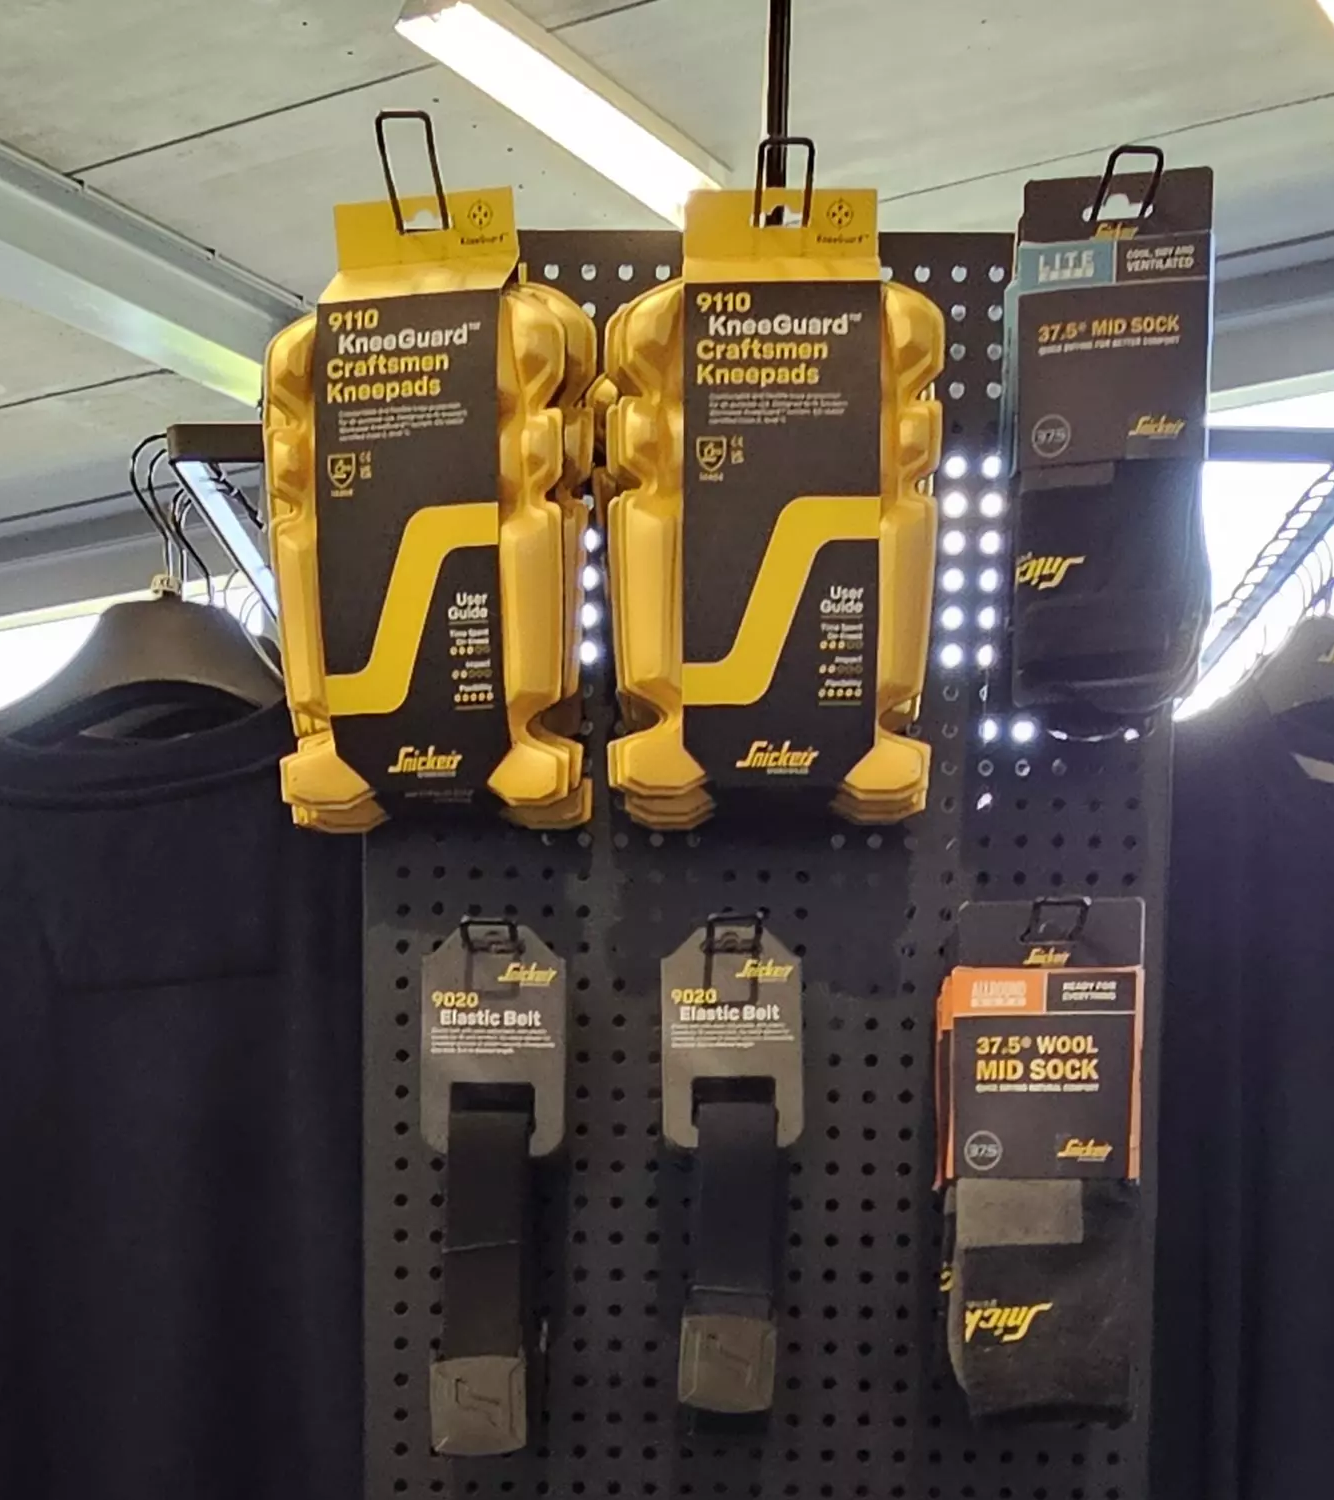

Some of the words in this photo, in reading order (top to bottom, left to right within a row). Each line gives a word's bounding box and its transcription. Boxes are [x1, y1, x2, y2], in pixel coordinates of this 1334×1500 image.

[696, 292, 751, 313] 9110
[328, 308, 379, 332] 9110
[1091, 318, 1127, 337] MID
[1130, 314, 1180, 334] SOCK
[696, 338, 829, 361] Craftsmen
[327, 353, 449, 380] Craftsmen
[696, 363, 820, 387] Kneepads
[327, 376, 441, 404] Kneepads
[1018, 555, 1086, 592] Snic
[455, 592, 488, 607] User
[829, 586, 864, 601] User
[448, 605, 488, 621] Guide
[819, 599, 864, 614] Guide
[387, 745, 463, 774] Snickers
[735, 739, 819, 768] Snickers
[431, 991, 479, 1008] 9020
[671, 988, 717, 1005] 9020
[440, 1009, 501, 1027] Elastic
[503, 1010, 542, 1027] Belt
[679, 1004, 740, 1022] Elastic
[742, 1004, 780, 1022] Belt
[1036, 1035, 1100, 1055] WOOL
[975, 1058, 1024, 1081] MID
[1029, 1058, 1100, 1081] SOCK
[965, 1302, 1054, 1343] Snick
